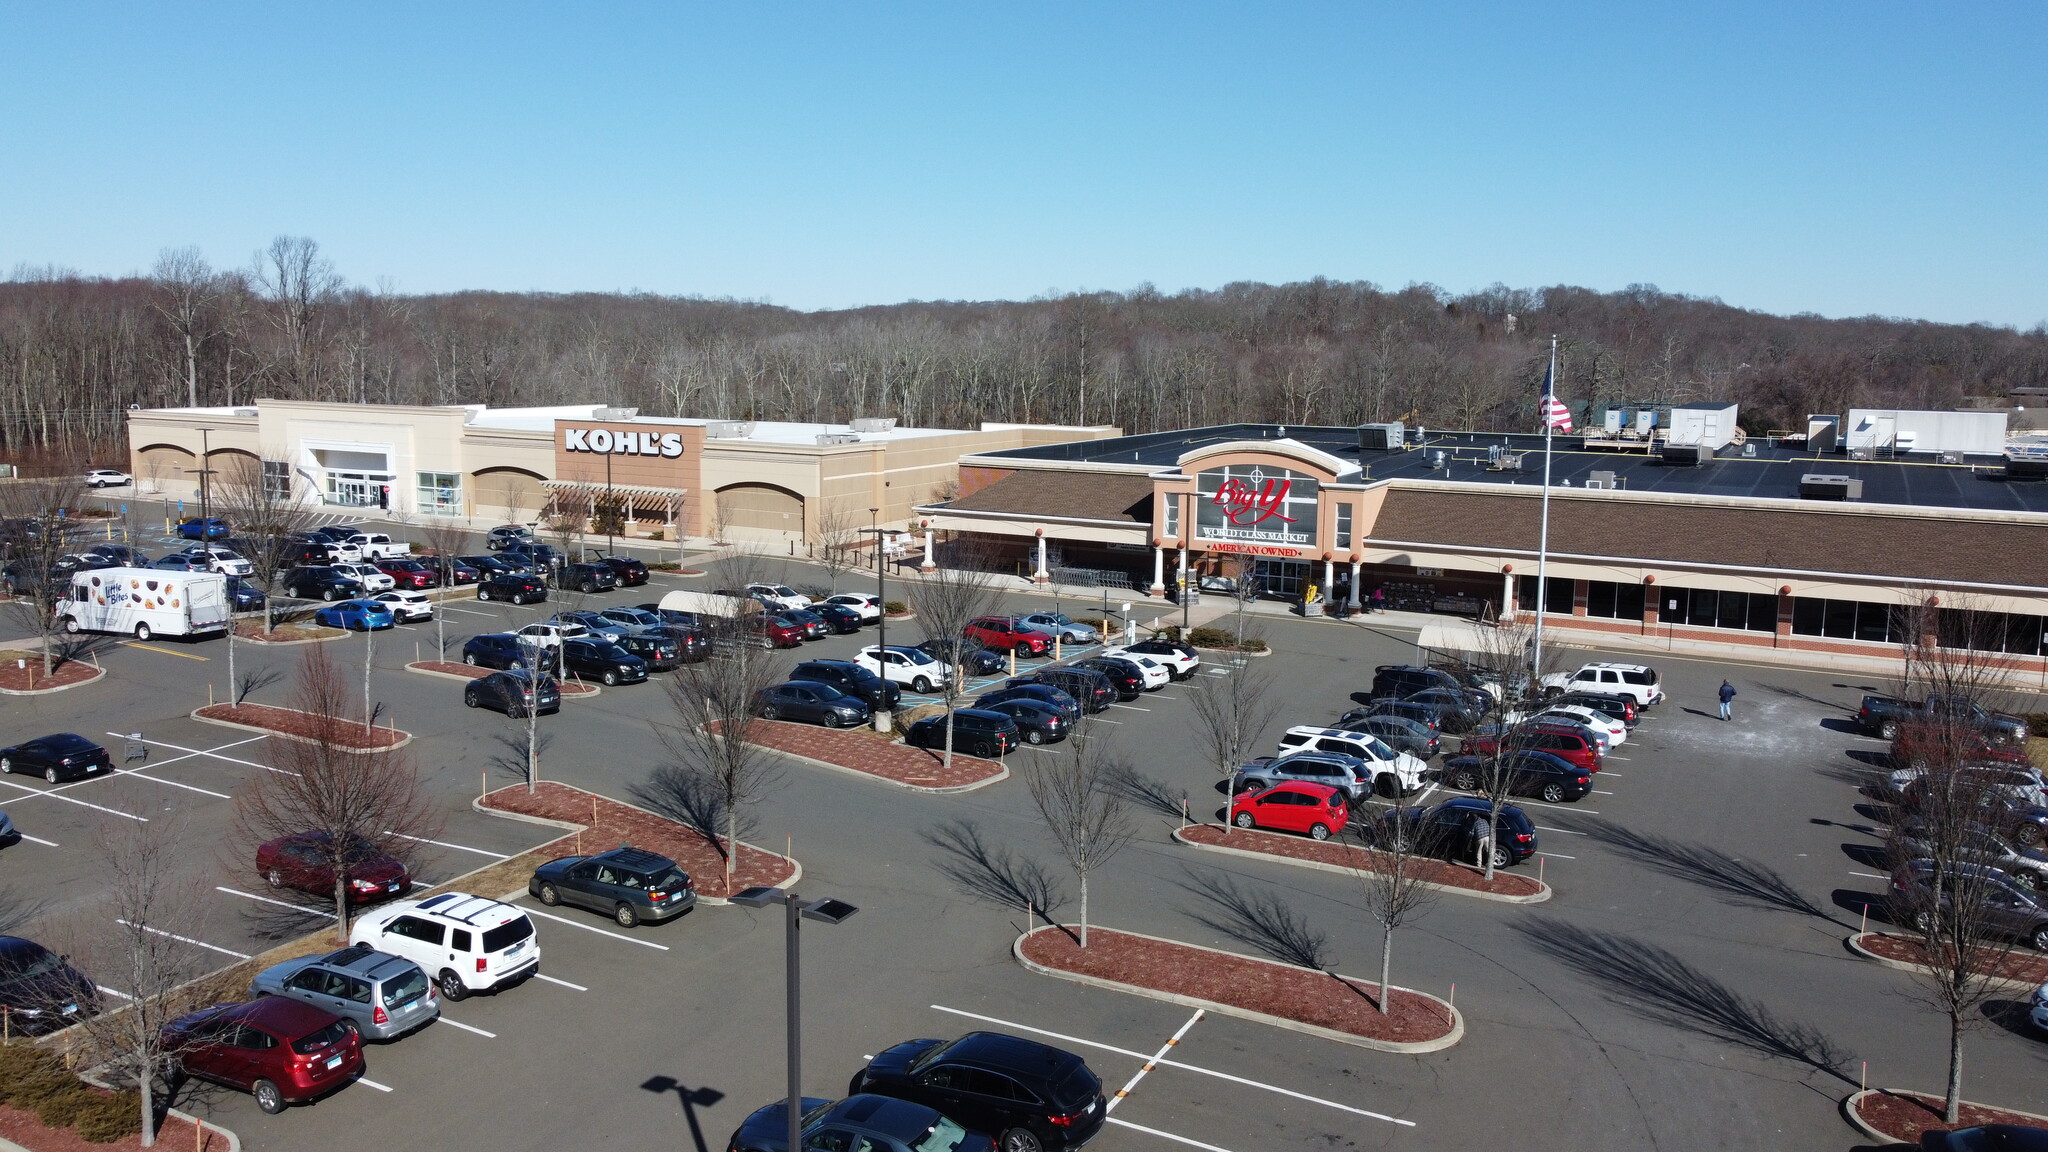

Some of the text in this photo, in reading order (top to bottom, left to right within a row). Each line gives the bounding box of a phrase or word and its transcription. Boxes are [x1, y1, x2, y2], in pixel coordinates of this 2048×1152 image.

[565, 429, 684, 459] KOHL'S
[1212, 479, 1259, 516] Big
[1202, 527, 1309, 543] WORLD CLASS MARKET
[1211, 543, 1298, 557] AMERICAN OWNED
[110, 593, 129, 605] Bites
